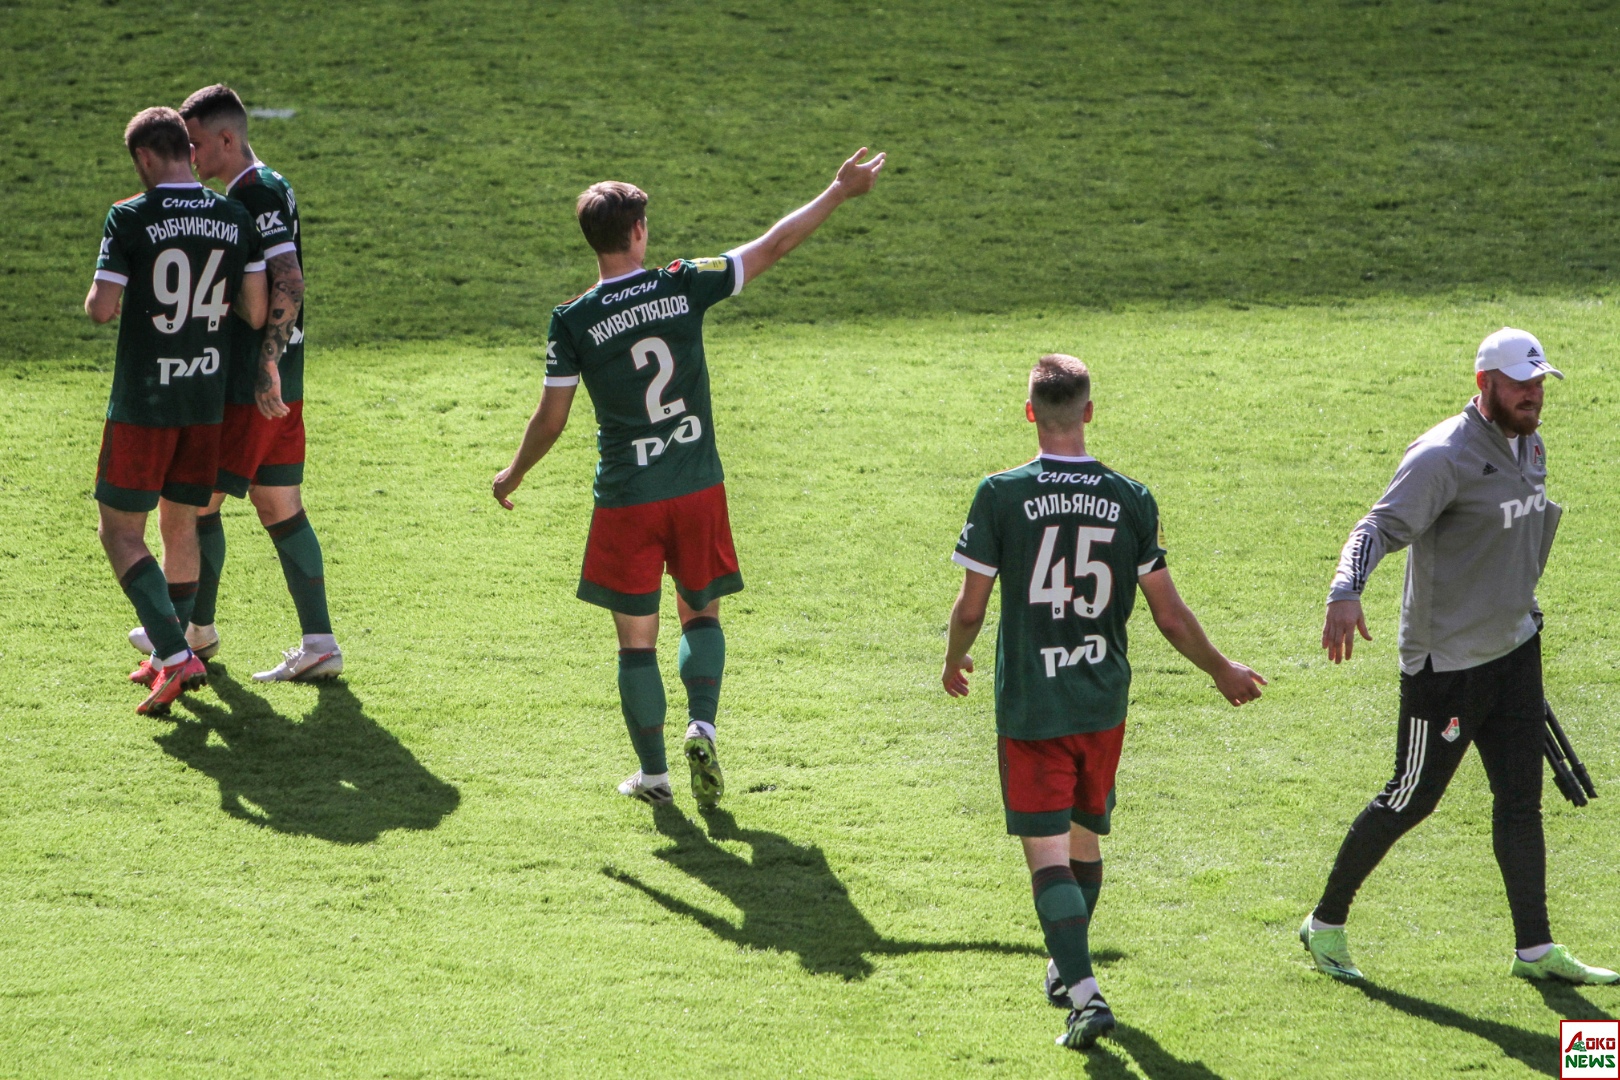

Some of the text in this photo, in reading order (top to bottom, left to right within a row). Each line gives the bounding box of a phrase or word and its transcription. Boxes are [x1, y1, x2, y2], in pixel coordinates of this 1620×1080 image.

[146, 216, 238, 245] РЫБЧИНСКИЙ
[152, 248, 230, 334] 94
[588, 296, 690, 346] ЖИВОГЛЯДОВ
[630, 336, 686, 424] 2
[1023, 493, 1121, 522] СИЛЬЯНОВ
[1029, 525, 1116, 620] 45
